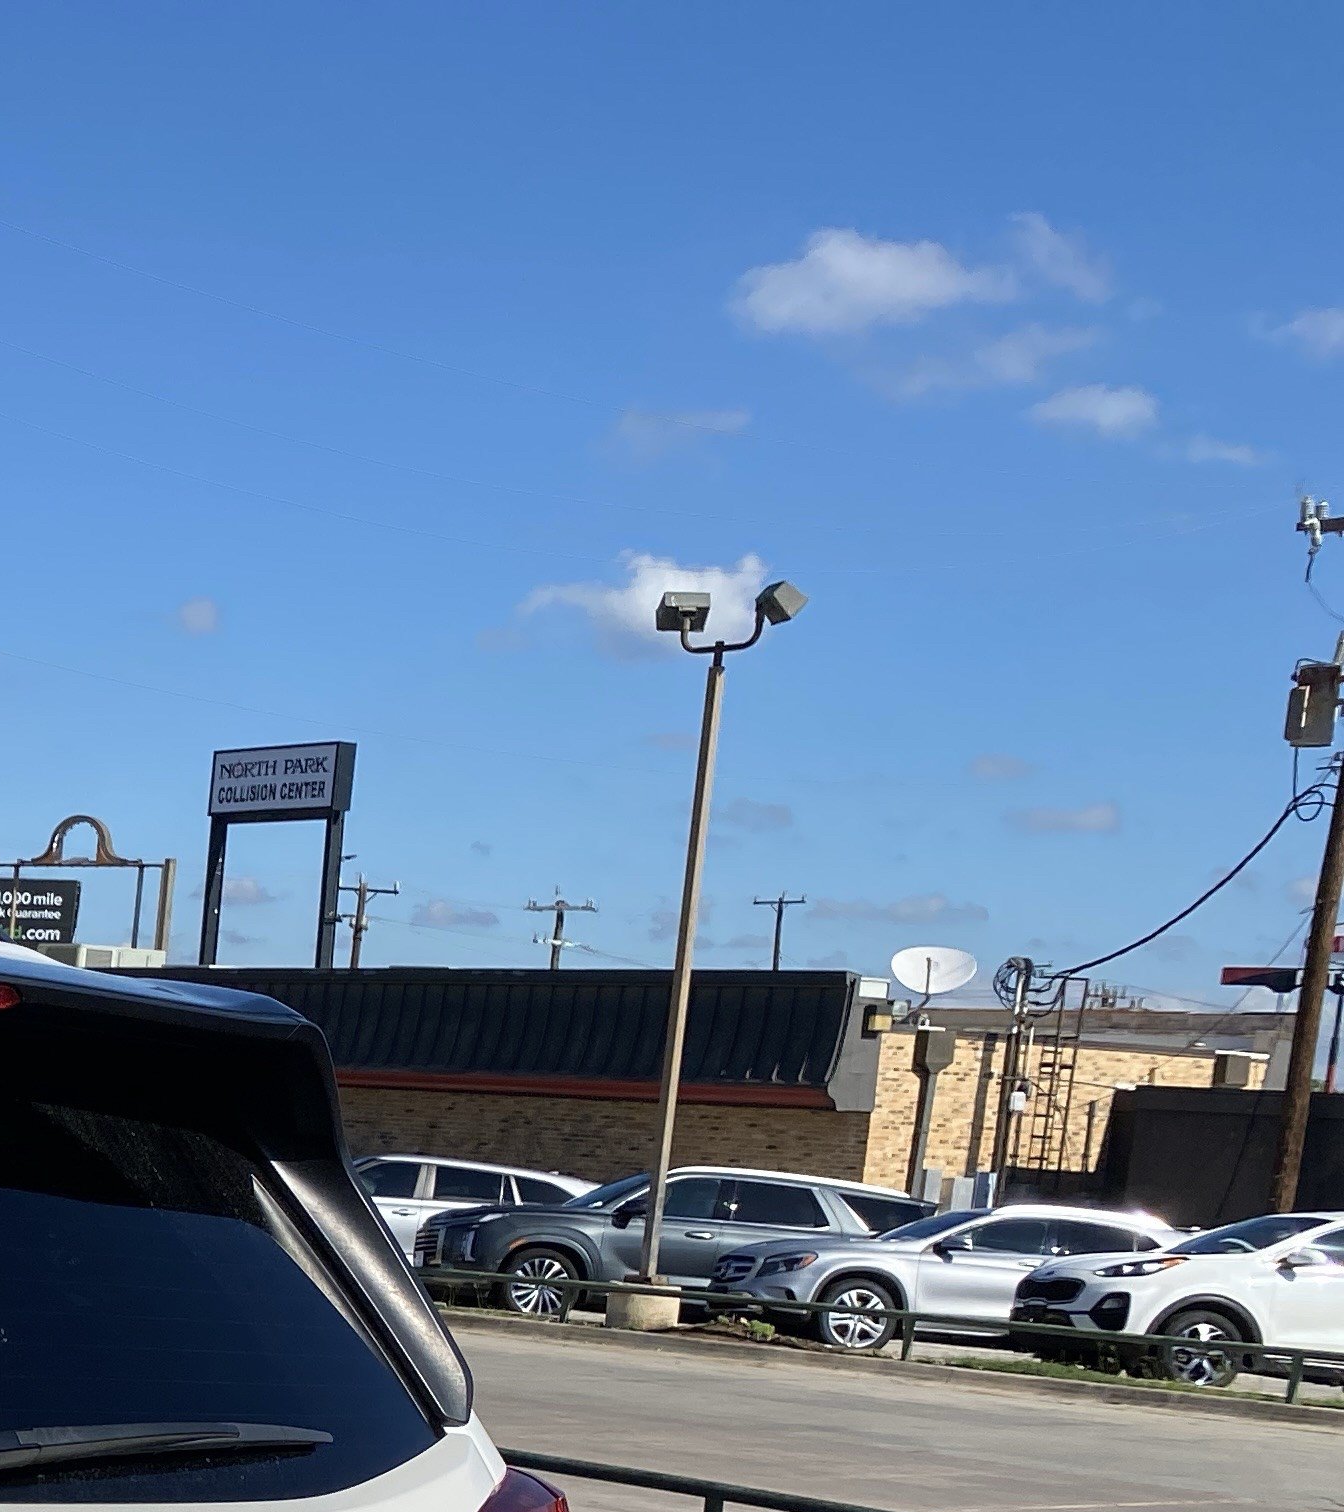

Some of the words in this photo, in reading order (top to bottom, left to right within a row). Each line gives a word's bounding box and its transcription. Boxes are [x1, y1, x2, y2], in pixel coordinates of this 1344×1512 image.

[219, 759, 277, 781] NORTH
[284, 755, 330, 775] PARK
[218, 782, 277, 804] COLLISION
[280, 780, 326, 800] CENTER
[33, 893, 63, 907] mile
